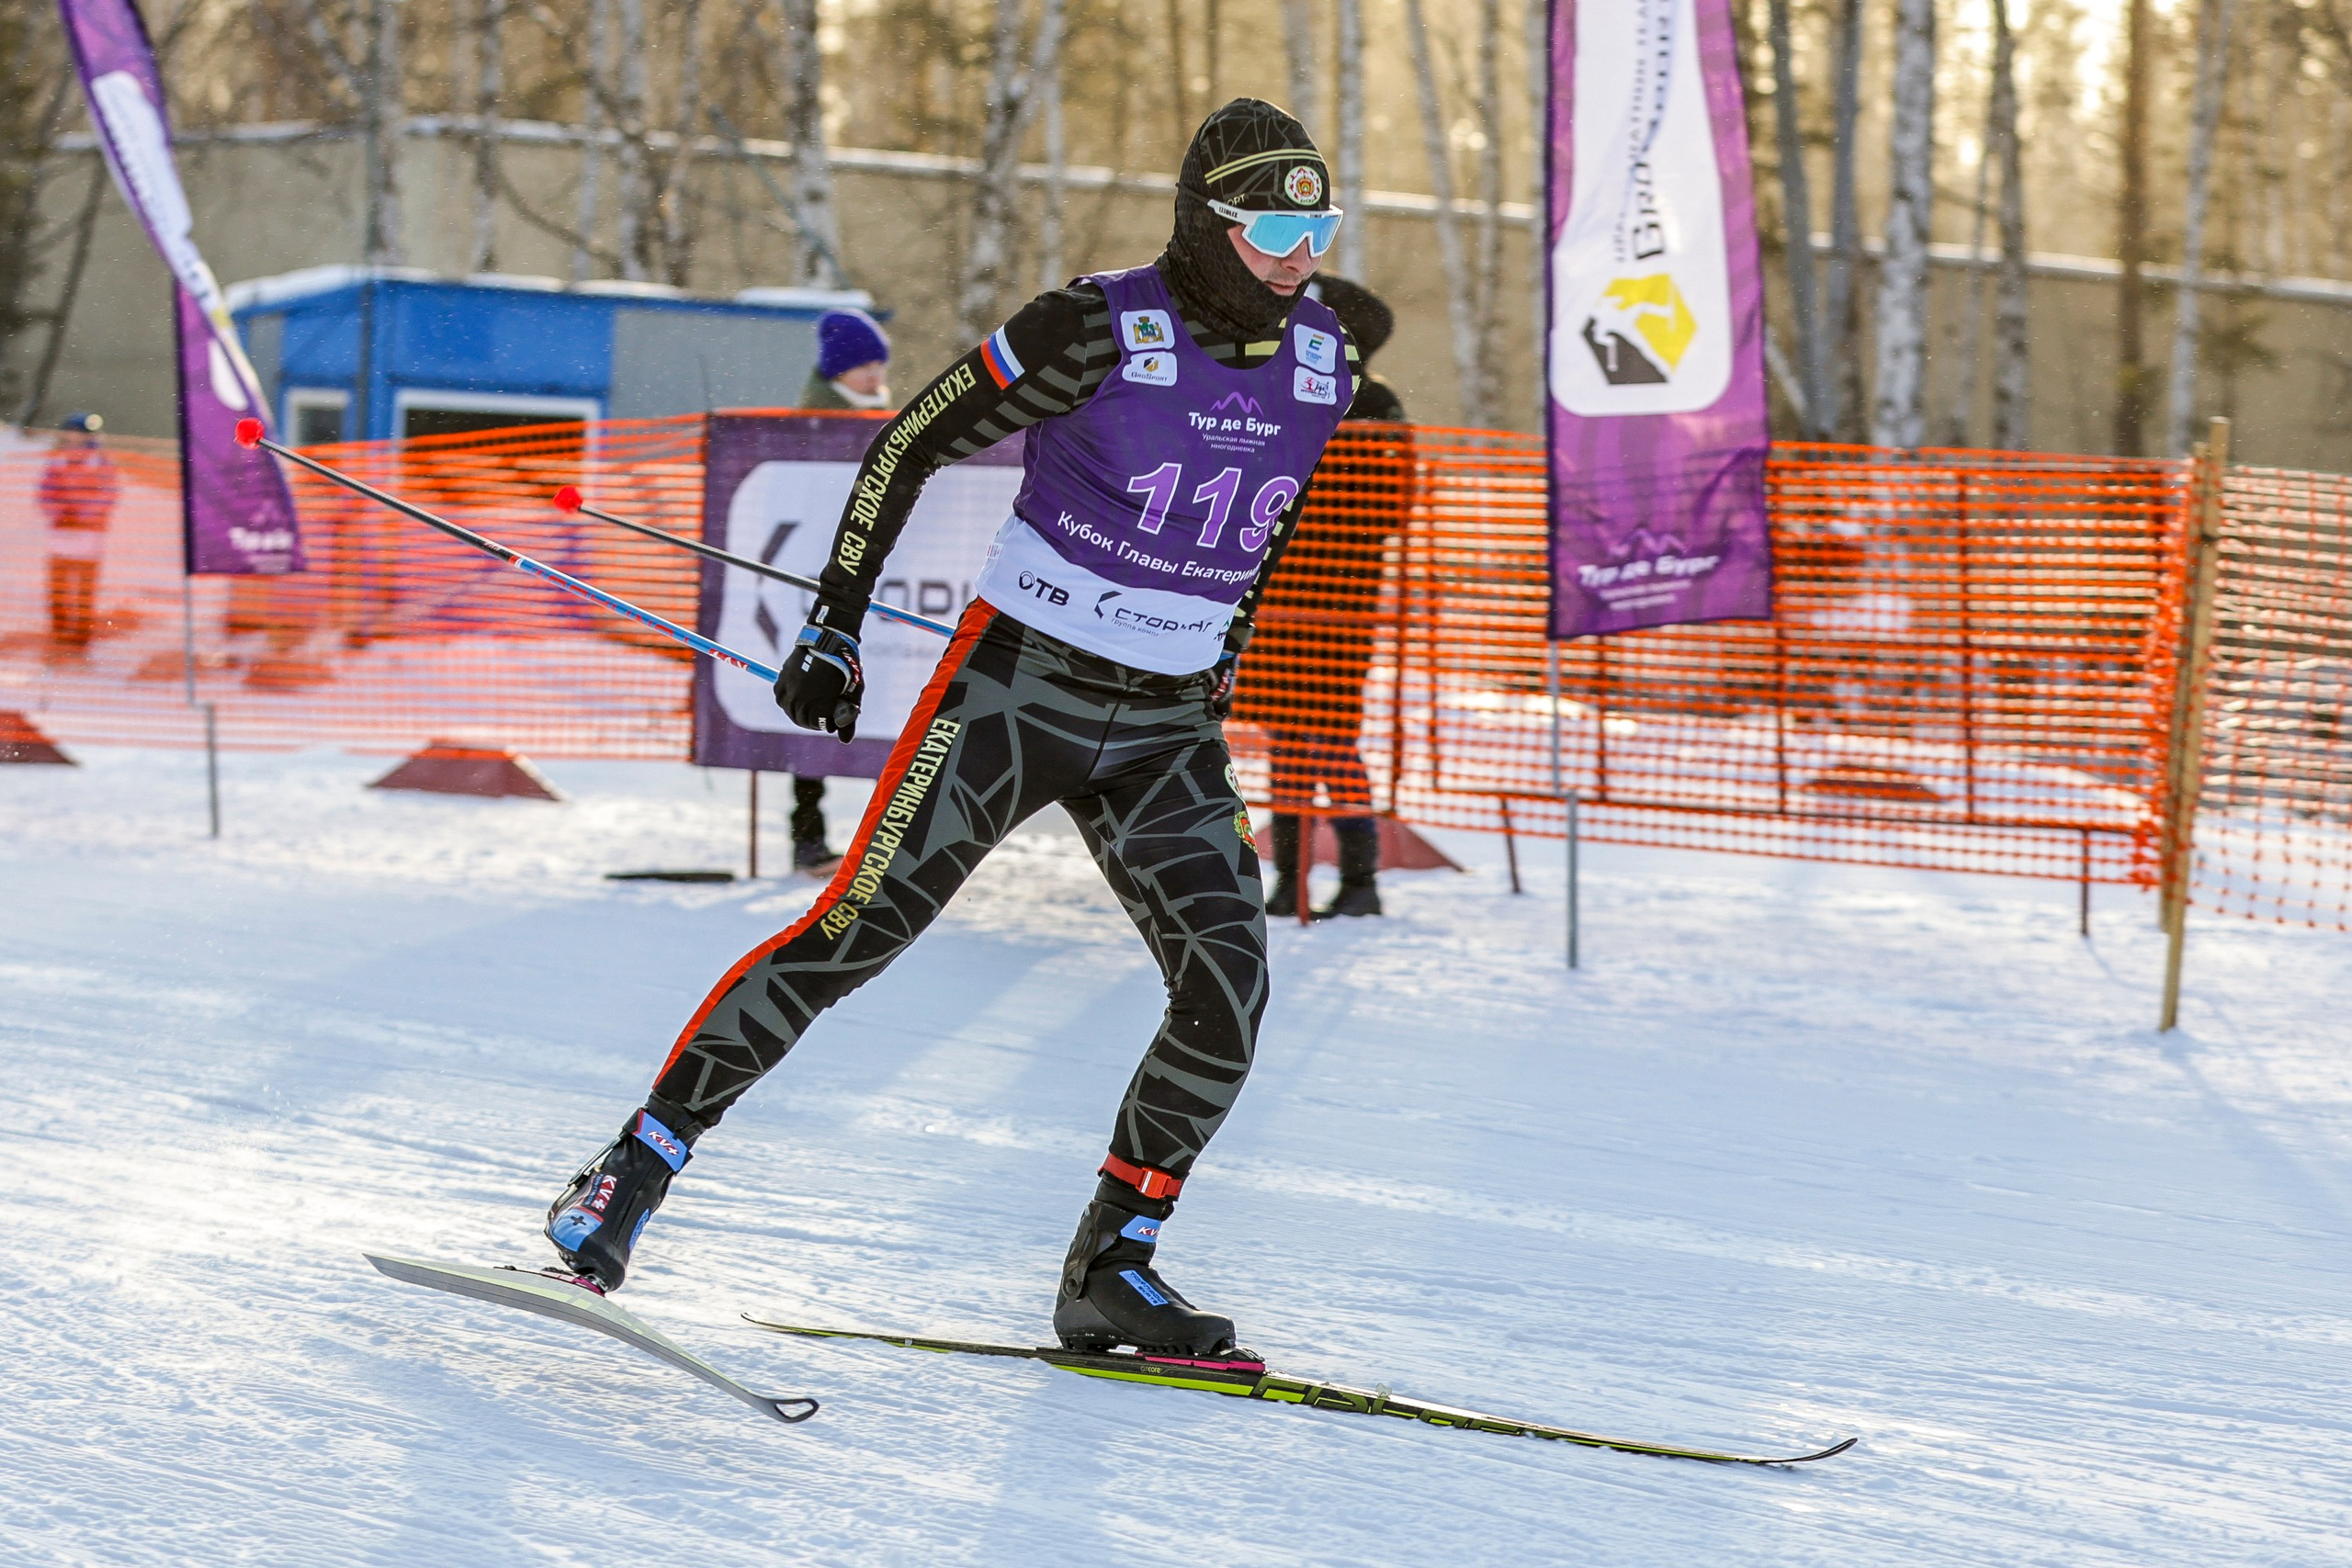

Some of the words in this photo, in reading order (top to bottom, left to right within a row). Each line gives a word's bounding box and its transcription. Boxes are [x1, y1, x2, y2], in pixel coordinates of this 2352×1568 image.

[850, 363, 977, 531] ЕКАТЕРИНБУРГСКОЕ
[1188, 412, 1217, 431] Тур
[1220, 418, 1241, 432] де
[1246, 417, 1282, 437] Бург
[1126, 462, 1300, 553] 119
[838, 531, 866, 576] СВУ
[1057, 511, 1114, 551] Кубок
[1116, 541, 1178, 574] Главы
[846, 717, 961, 905] ЕКАТЕРИНБУРГСКОЕ
[820, 901, 859, 941] СВУ
[1136, 1226, 1160, 1236] KV
